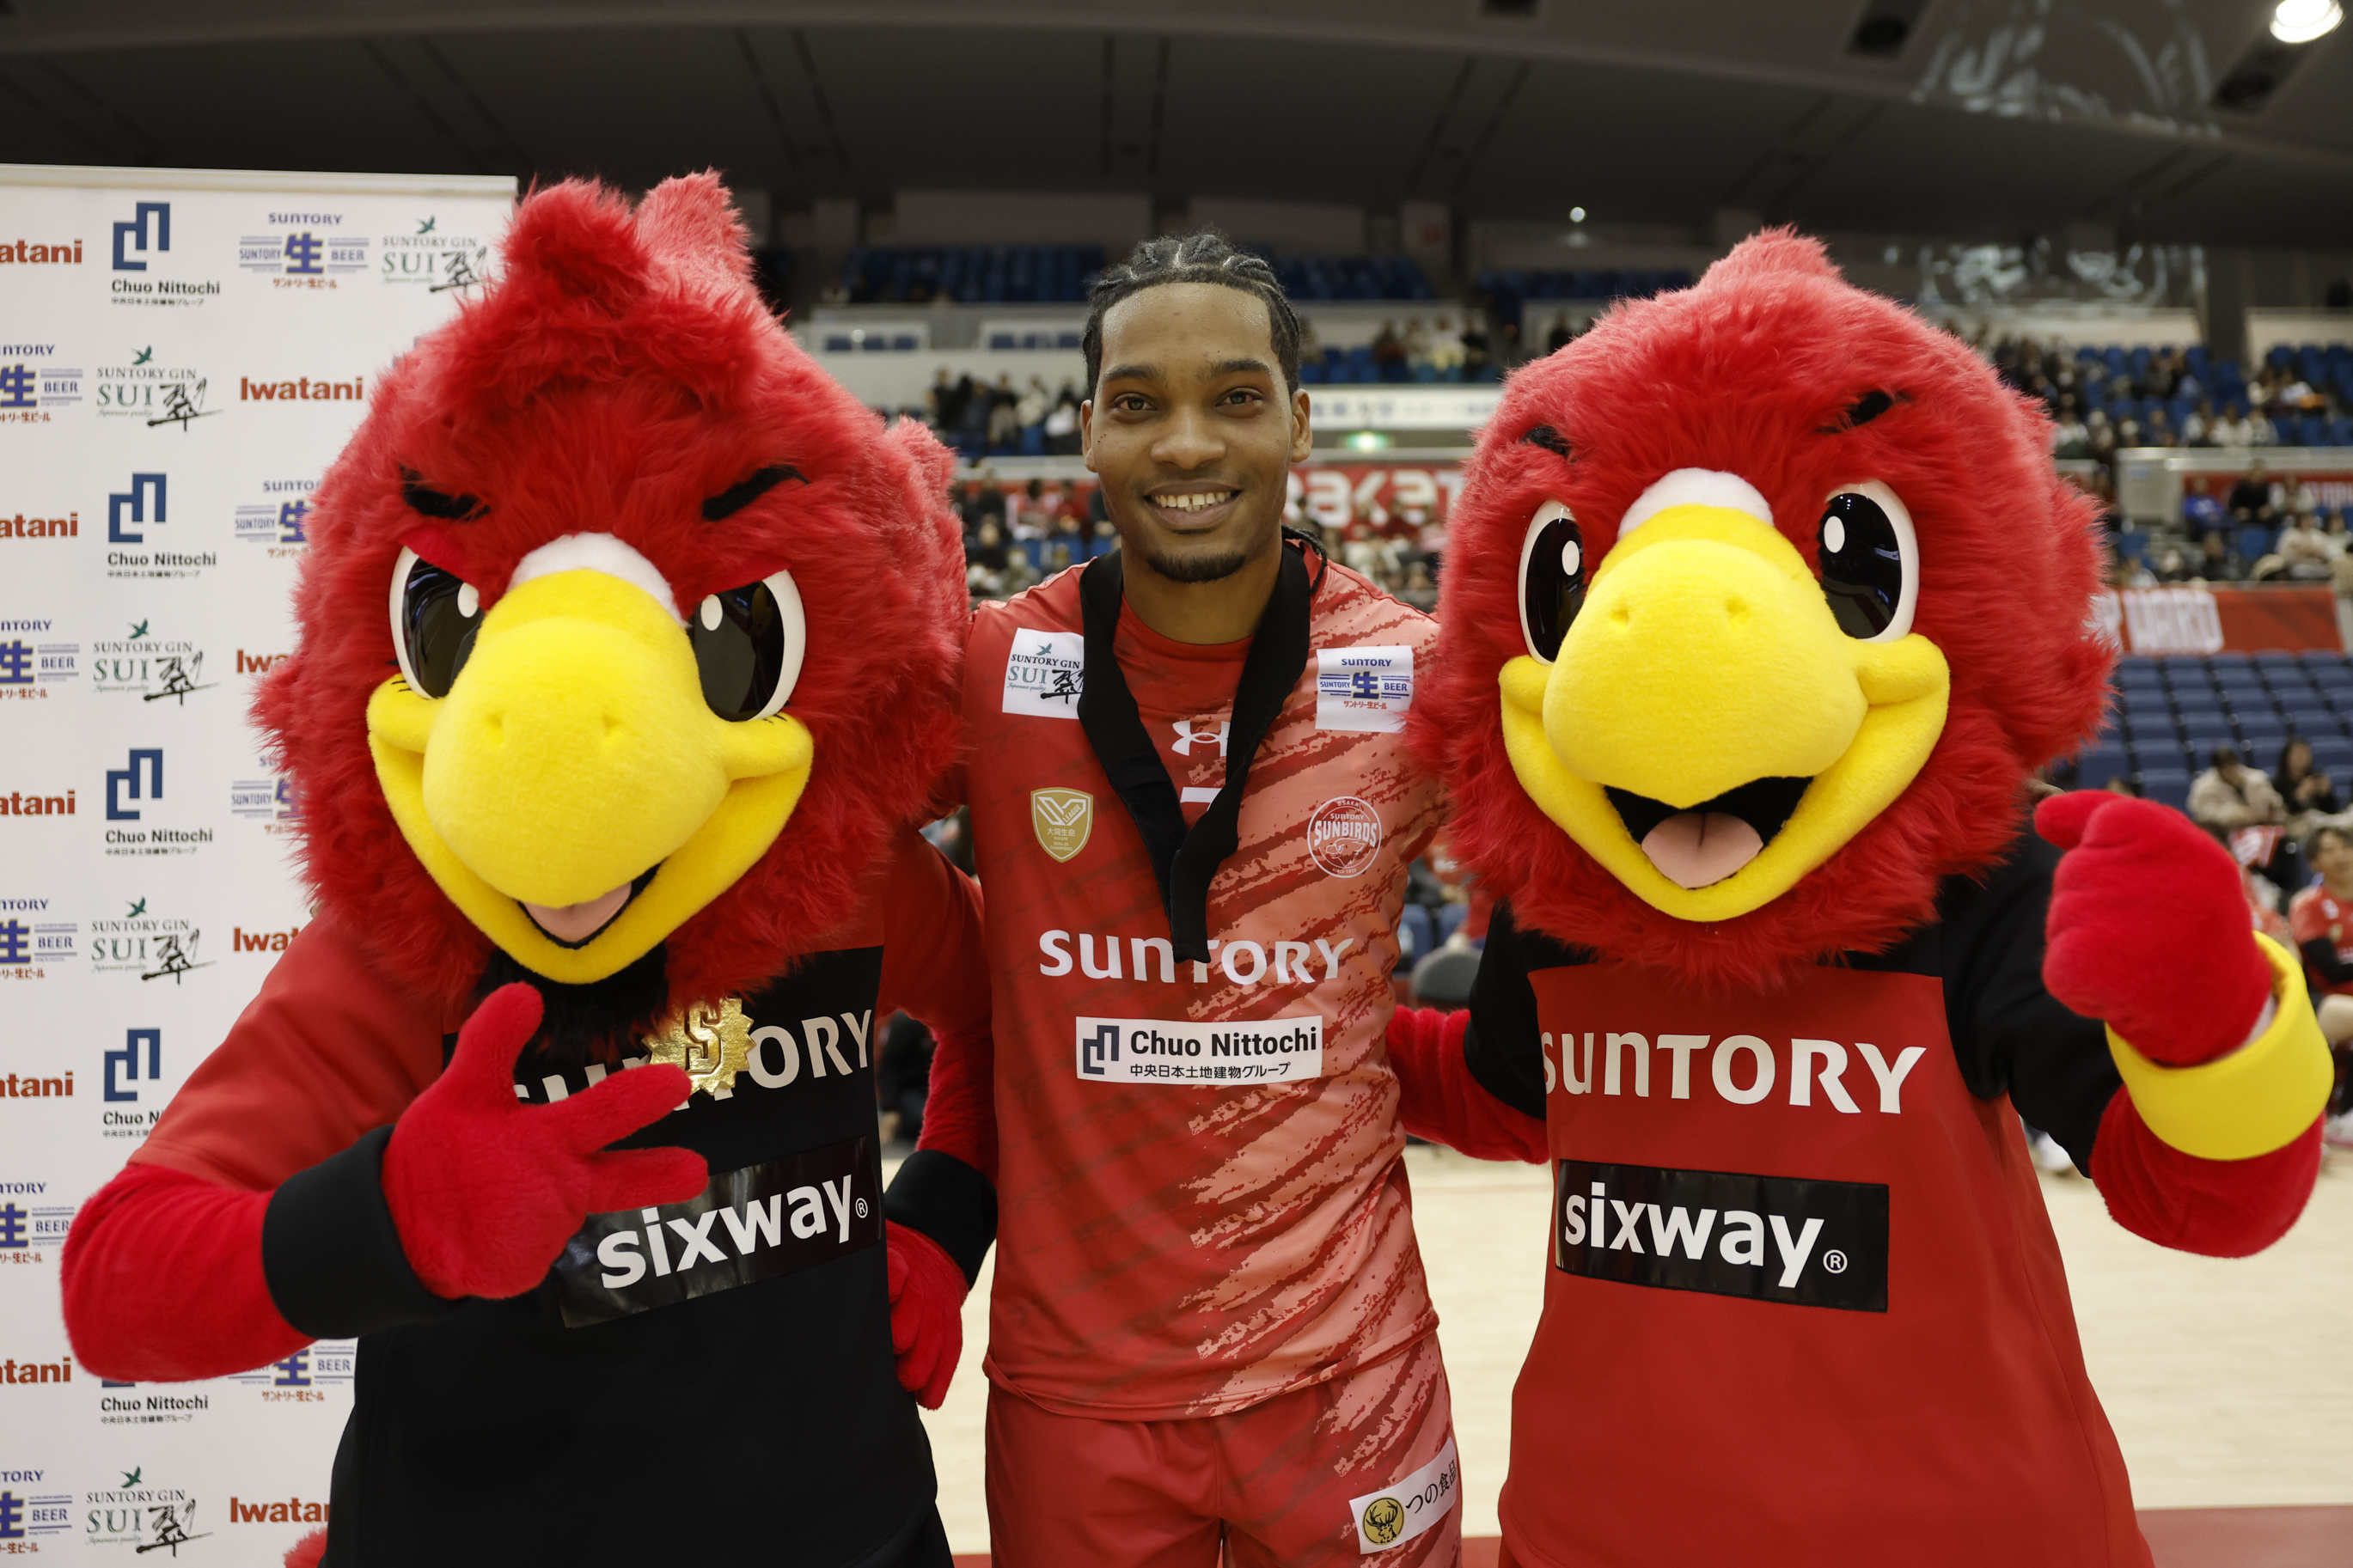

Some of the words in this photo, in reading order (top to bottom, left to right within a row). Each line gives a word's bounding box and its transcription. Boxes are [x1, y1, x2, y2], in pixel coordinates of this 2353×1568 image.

[382, 235, 449, 248] SUNTORY
[450, 236, 478, 247] GIN
[284, 232, 324, 274] 生
[330, 249, 365, 261] BEER
[382, 251, 436, 274] SUI
[112, 278, 153, 293] Chuo
[158, 280, 221, 295] Nittochi
[0, 344, 55, 357] NTORY
[96, 367, 165, 380] SUNTORY
[168, 368, 197, 380] GIN
[0, 363, 37, 409] 生
[44, 381, 78, 394] BEER
[240, 375, 364, 401] Iwatani
[96, 383, 154, 407] SUI
[262, 479, 320, 492] SUNTO
[107, 551, 149, 565] Chuo
[154, 552, 217, 565] Nittochi
[93, 641, 162, 654] SUNTORY
[164, 641, 193, 654] GIN
[40, 656, 76, 669] BEER
[1011, 654, 1059, 667] SUNTORY
[1060, 660, 1080, 669] GIN
[1341, 658, 1392, 667] SUNTORY
[93, 658, 149, 682] SUI
[1007, 665, 1048, 685] SUI
[1352, 671, 1380, 699] 生
[1384, 682, 1408, 692] BEER
[1062, 804, 1082, 823] LEAGUE
[106, 828, 146, 843] Chuo
[151, 828, 213, 843] Nittochi
[1047, 827, 1076, 837] 大同生命
[1314, 820, 1378, 848] SUNBIRDS
[91, 919, 159, 934] SUNTORY
[162, 918, 191, 932] GIN
[38, 936, 74, 949] BEER
[91, 937, 148, 962] SUI
[1131, 1030, 1201, 1058] Chuo
[1211, 1027, 1317, 1057] Nittochi
[1130, 1061, 1292, 1079] 中央日本土地建物グループ
[1541, 1031, 1928, 1115] SUNTORY
[103, 1110, 144, 1125] Chuo
[35, 1219, 70, 1233] BEER
[0, 1357, 71, 1385] tani
[317, 1358, 351, 1372] BEER
[101, 1396, 141, 1412] Chuo
[146, 1394, 209, 1411] Nittochi
[86, 1491, 154, 1504] SUNTORY
[157, 1489, 186, 1502] GIN
[32, 1508, 68, 1522] BEER
[86, 1508, 143, 1534] SUI
